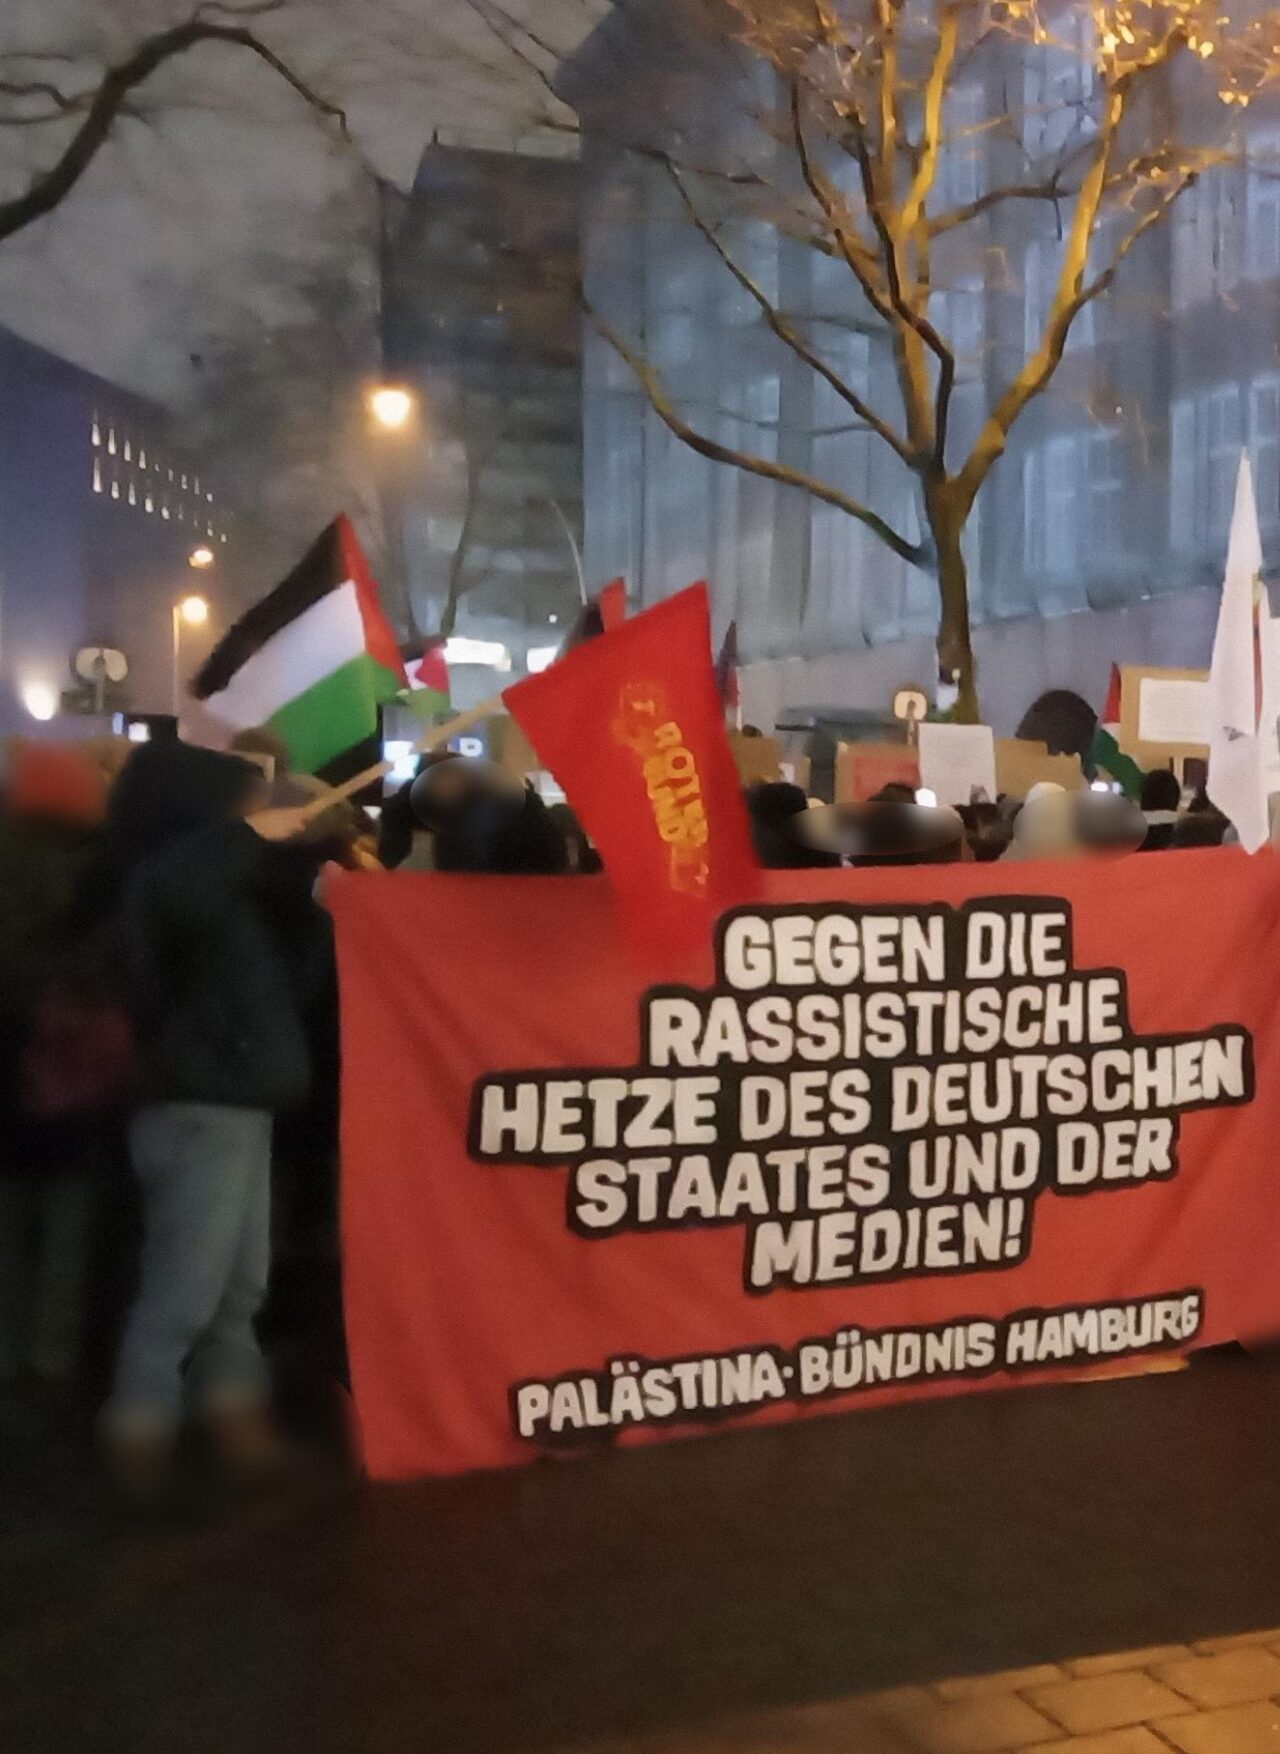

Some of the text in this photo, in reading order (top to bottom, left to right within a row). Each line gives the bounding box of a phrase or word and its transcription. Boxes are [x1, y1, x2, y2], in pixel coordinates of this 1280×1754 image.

[724, 911, 1067, 990] GEGEN DIE
[649, 977, 1123, 1067] RASSISTISCHE
[480, 1035, 1244, 1154] HETZE DES DEUTSCHEN
[575, 1117, 1173, 1227] STAATES UND DER
[751, 1196, 1024, 1286] MEDIEN!
[1006, 1295, 1200, 1364] HAMBURG
